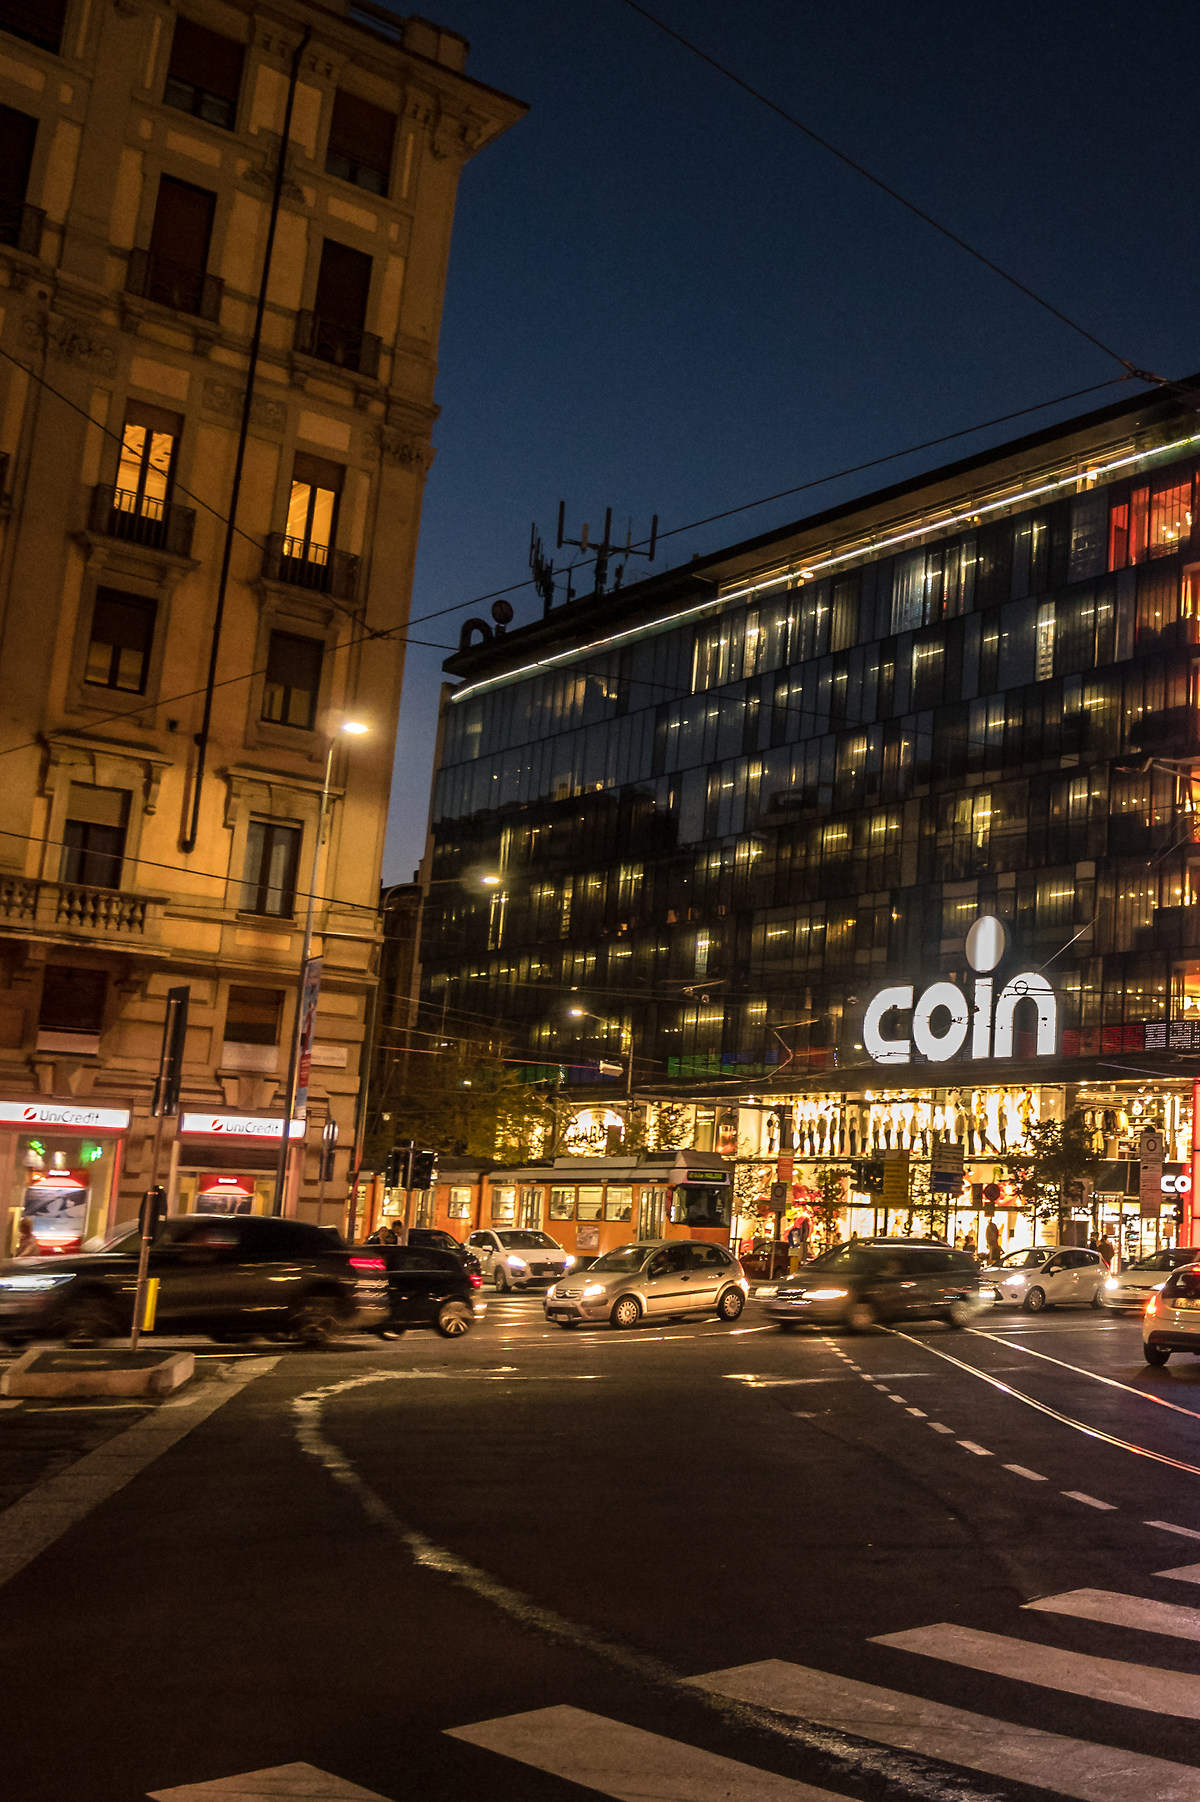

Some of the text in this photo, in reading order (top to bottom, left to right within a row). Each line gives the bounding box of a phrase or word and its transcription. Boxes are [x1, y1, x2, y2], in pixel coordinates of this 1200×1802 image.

[863, 915, 1058, 1064] coin
[39, 1109, 100, 1124] UniCredit
[225, 1121, 279, 1135] UniCredit
